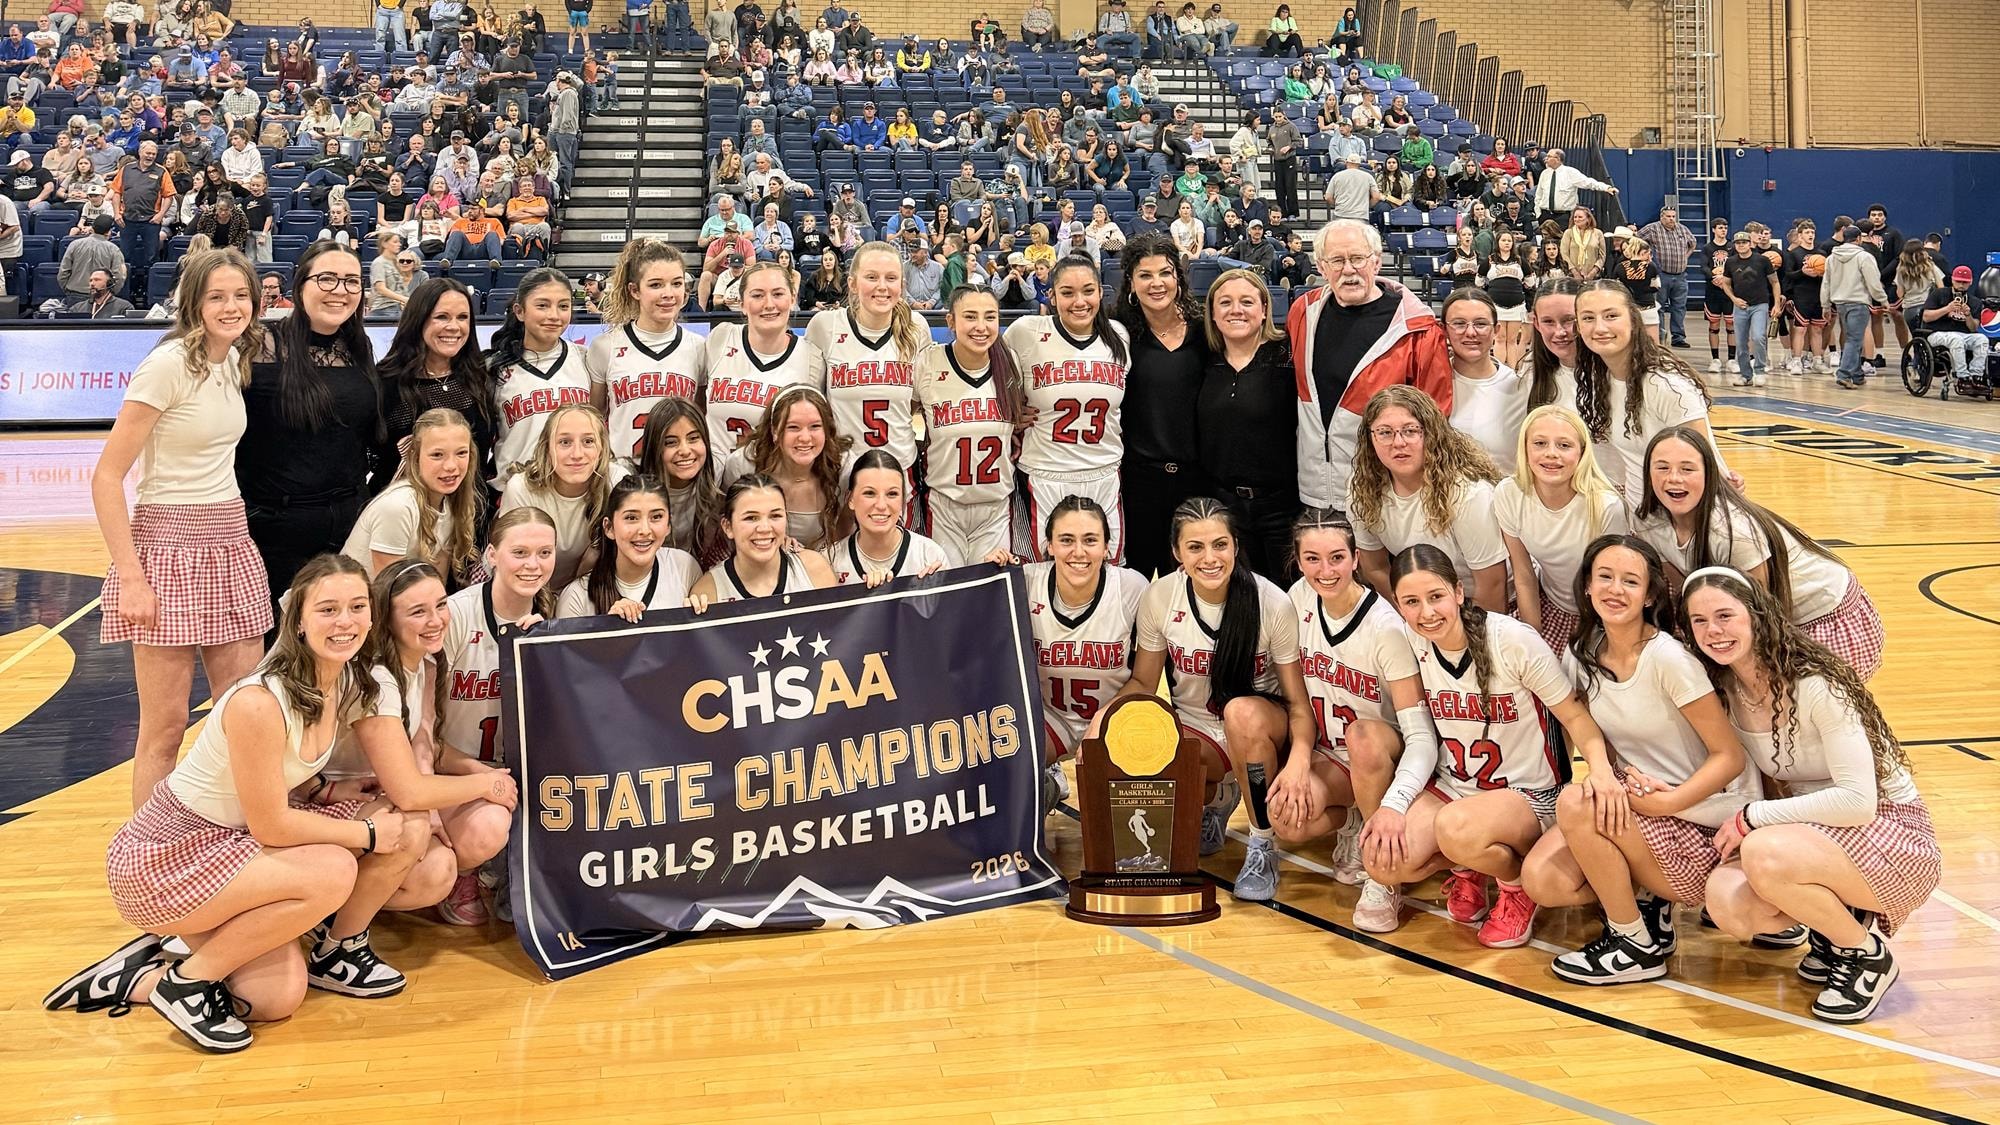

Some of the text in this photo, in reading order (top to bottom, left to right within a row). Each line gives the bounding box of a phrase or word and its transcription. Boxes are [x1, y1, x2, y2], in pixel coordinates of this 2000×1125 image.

[32, 372, 75, 390] JOIN
[80, 371, 114, 389] THE
[1031, 359, 1127, 390] McCLAVE
[863, 399, 889, 447] 5
[931, 397, 1005, 428] McCLA
[1052, 398, 1110, 444] 23
[955, 435, 1002, 486] 12
[681, 652, 898, 733] CHSAA
[1047, 676, 1101, 720] 15
[1424, 688, 1519, 724] cCLAVE
[539, 762, 714, 833] STATE
[735, 703, 1022, 813] CHAMPIONS
[1118, 789, 1166, 797] BASKETBALL
[1130, 782, 1154, 790] GIRLS
[578, 783, 997, 888] GIRLS BASKETBALL
[970, 850, 1031, 885] 2026
[1104, 878, 1183, 887] STATE CHAMPION
[557, 931, 587, 952] 1A
